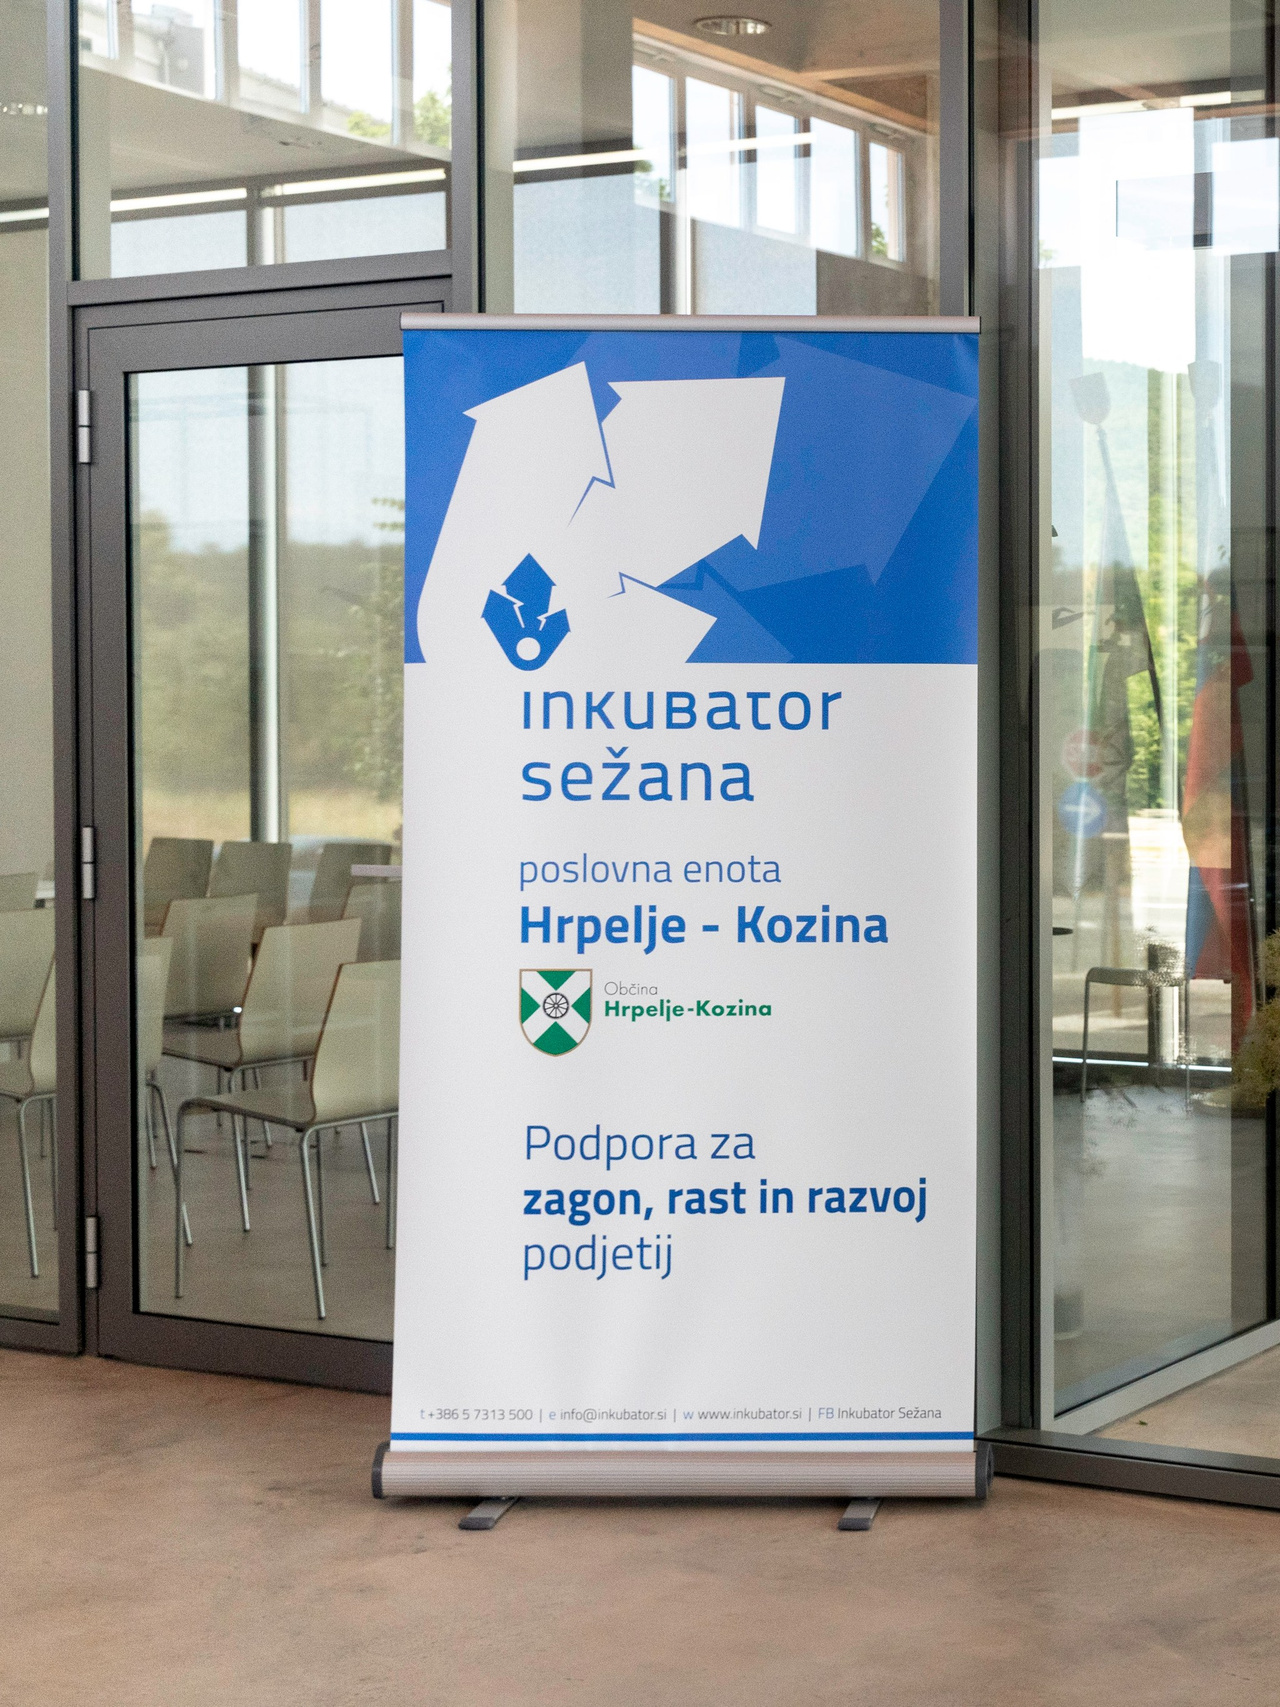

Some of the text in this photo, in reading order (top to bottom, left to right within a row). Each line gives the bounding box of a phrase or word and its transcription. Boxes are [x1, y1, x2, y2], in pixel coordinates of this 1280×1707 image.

[521, 746, 755, 802] sežana
[519, 852, 782, 891] poslovna enota
[520, 904, 687, 955] Hrpelje
[737, 904, 889, 944] Kozina
[604, 980, 658, 996] Občina
[604, 998, 773, 1022] Hrpelje-Kozina
[526, 1123, 756, 1171] Podpora za
[523, 1177, 928, 1226] zagon, rast in razvoj
[523, 1234, 673, 1281] podjetij
[428, 1408, 459, 1421] +386
[462, 1408, 471, 1421] 5
[508, 1408, 534, 1421] 500
[548, 1411, 557, 1421] e
[560, 1407, 667, 1423] info@inkubator.si
[683, 1411, 695, 1420] w
[697, 1407, 803, 1420] www.inkubator.si
[817, 1407, 835, 1420] FB
[837, 1406, 896, 1420] Inkubator
[898, 1405, 943, 1420] Sežana
